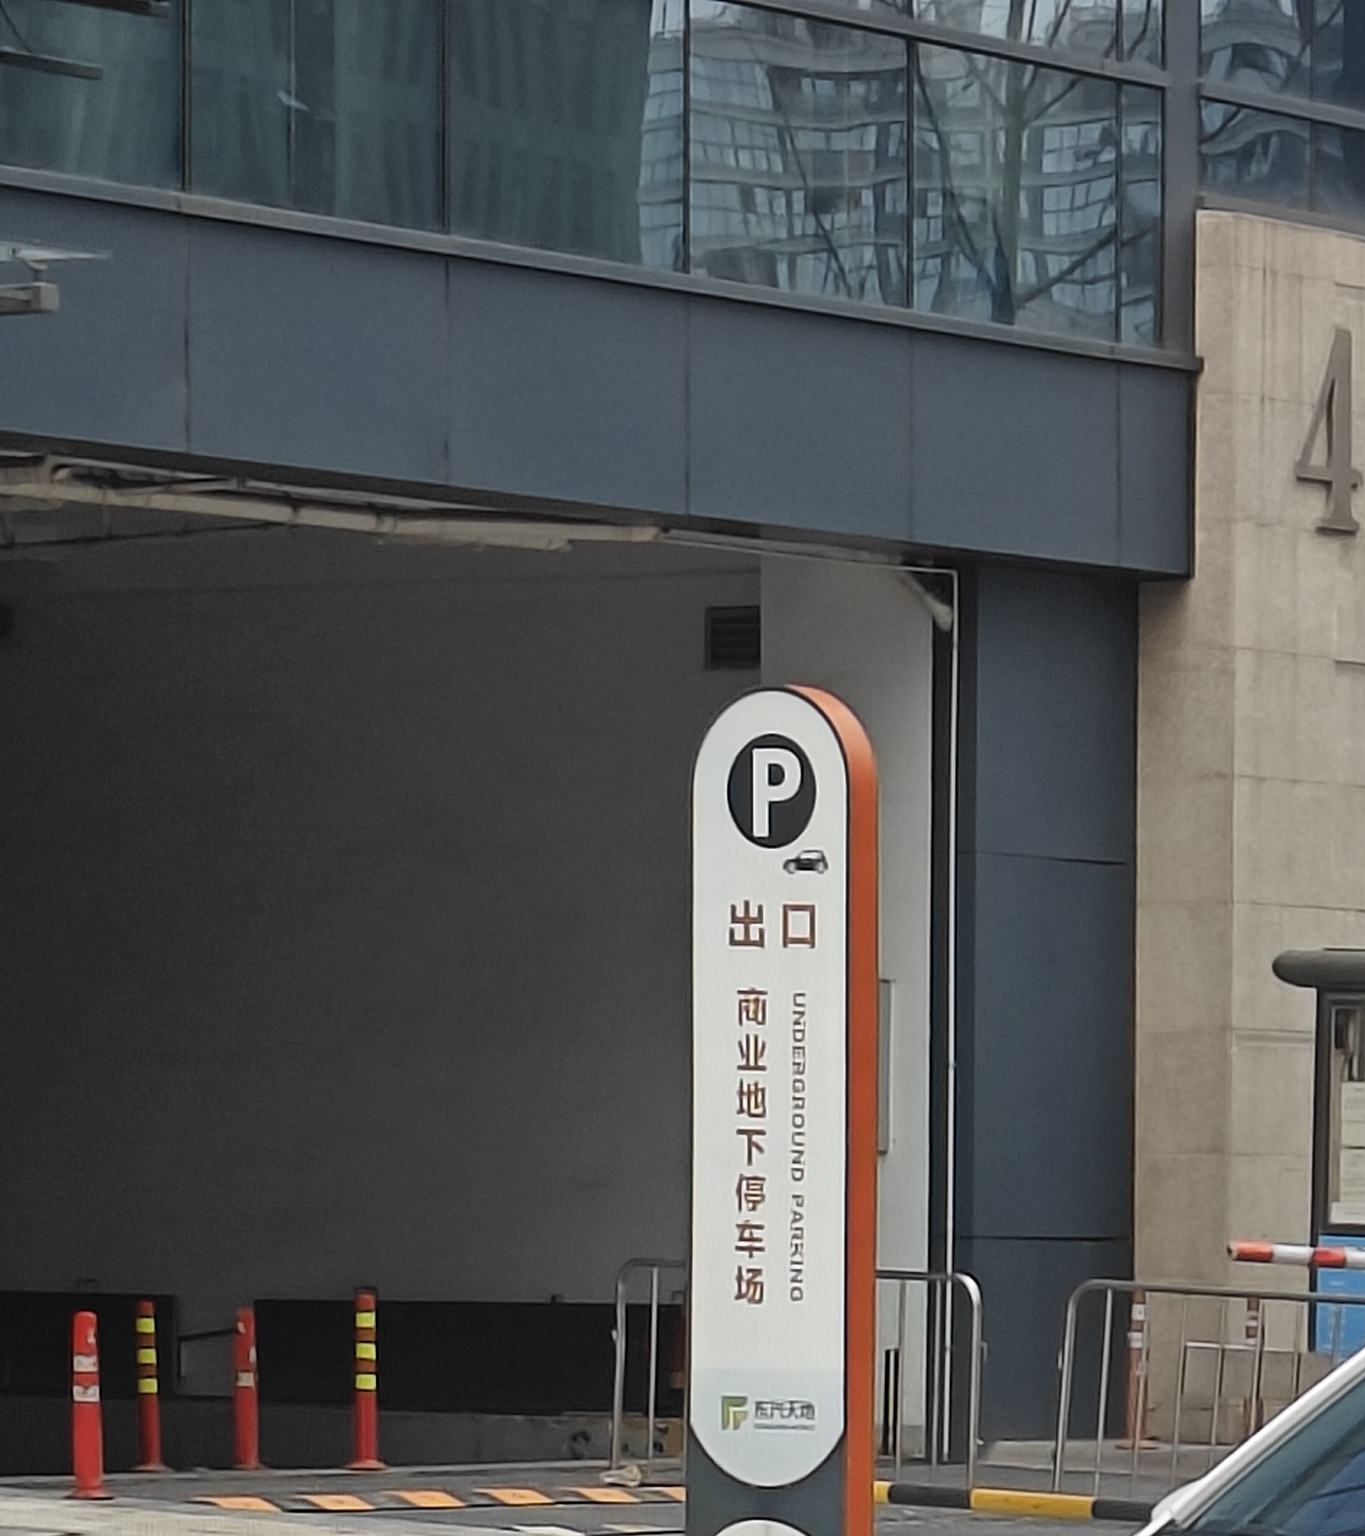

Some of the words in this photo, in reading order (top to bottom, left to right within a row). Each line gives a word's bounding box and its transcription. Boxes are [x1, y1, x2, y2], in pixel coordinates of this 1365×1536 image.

[1296, 327, 1363, 537] 4
[753, 747, 801, 838] P
[728, 899, 816, 949] 出口
[735, 987, 768, 1305] 商业地下停车场
[791, 992, 806, 1183] UNDERGROUND
[789, 1193, 805, 1303] PARKING
